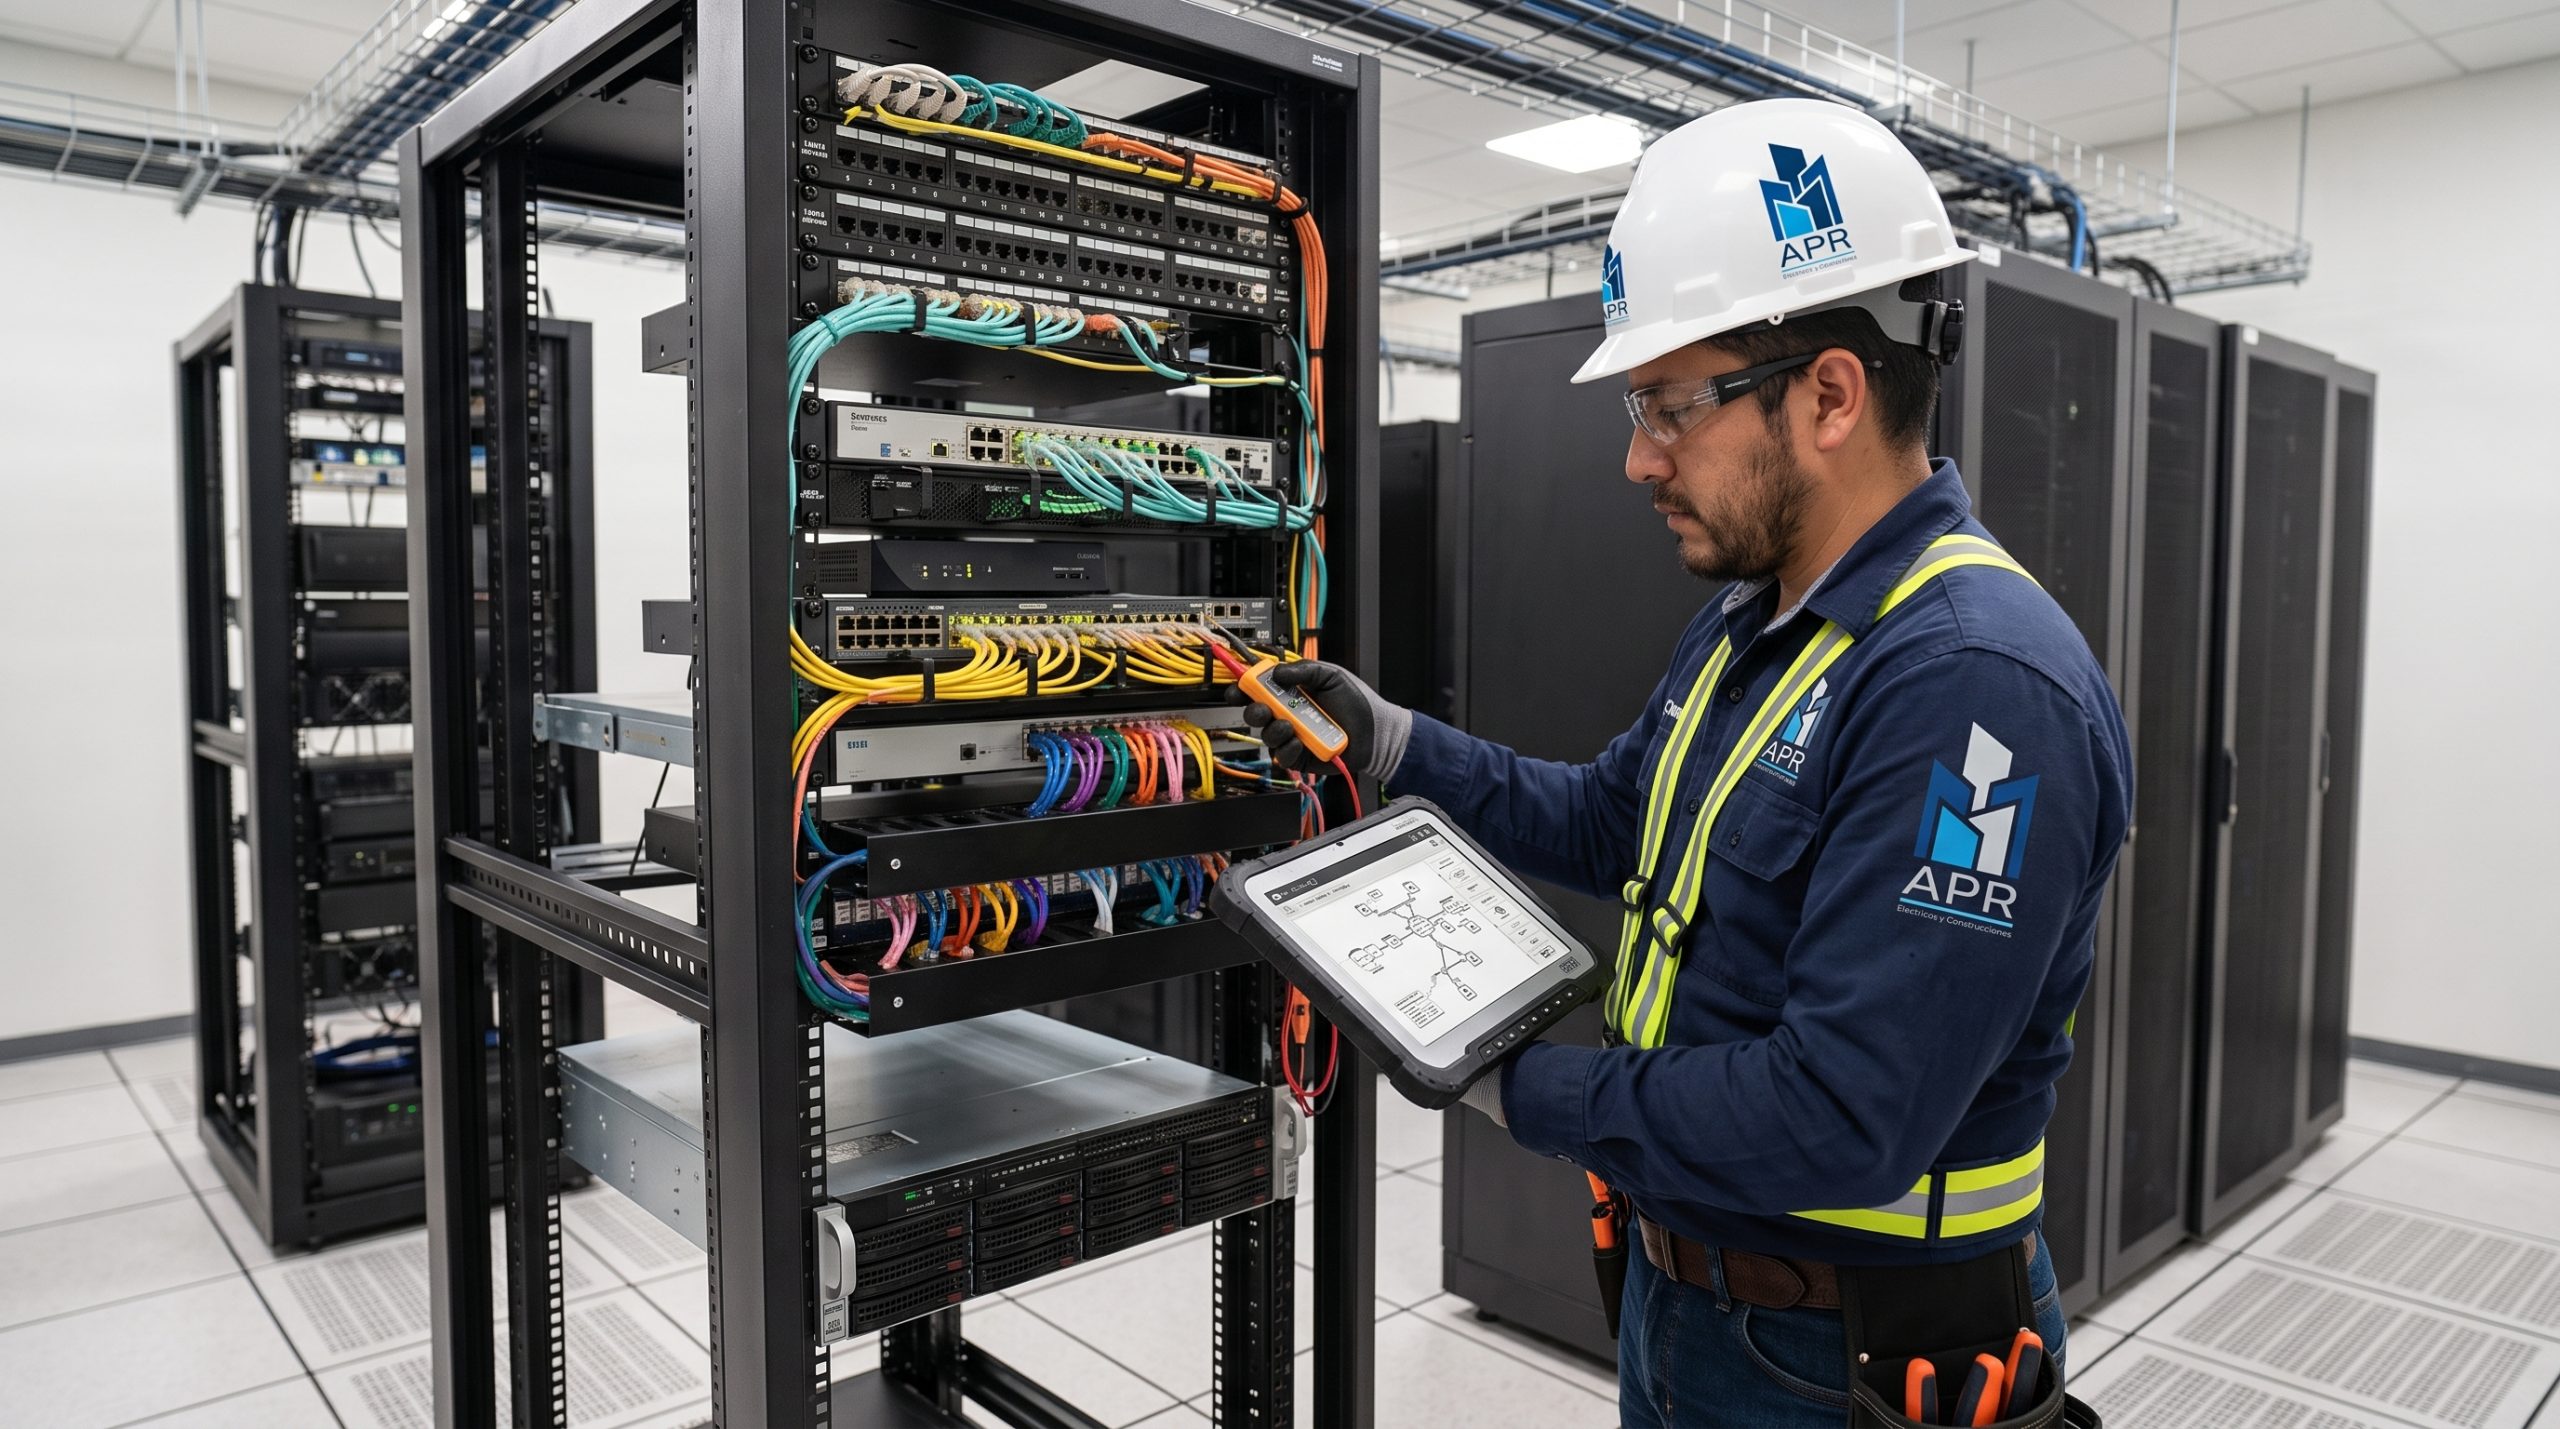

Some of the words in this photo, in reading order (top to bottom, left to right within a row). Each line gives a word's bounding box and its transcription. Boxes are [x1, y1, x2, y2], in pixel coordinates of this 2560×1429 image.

[1781, 228, 1852, 268] APR
[1761, 740, 1806, 773] APR
[1901, 865, 2018, 919] APR
[1897, 904, 1938, 920] Electricos
[1946, 916, 2012, 938] Construcciones
